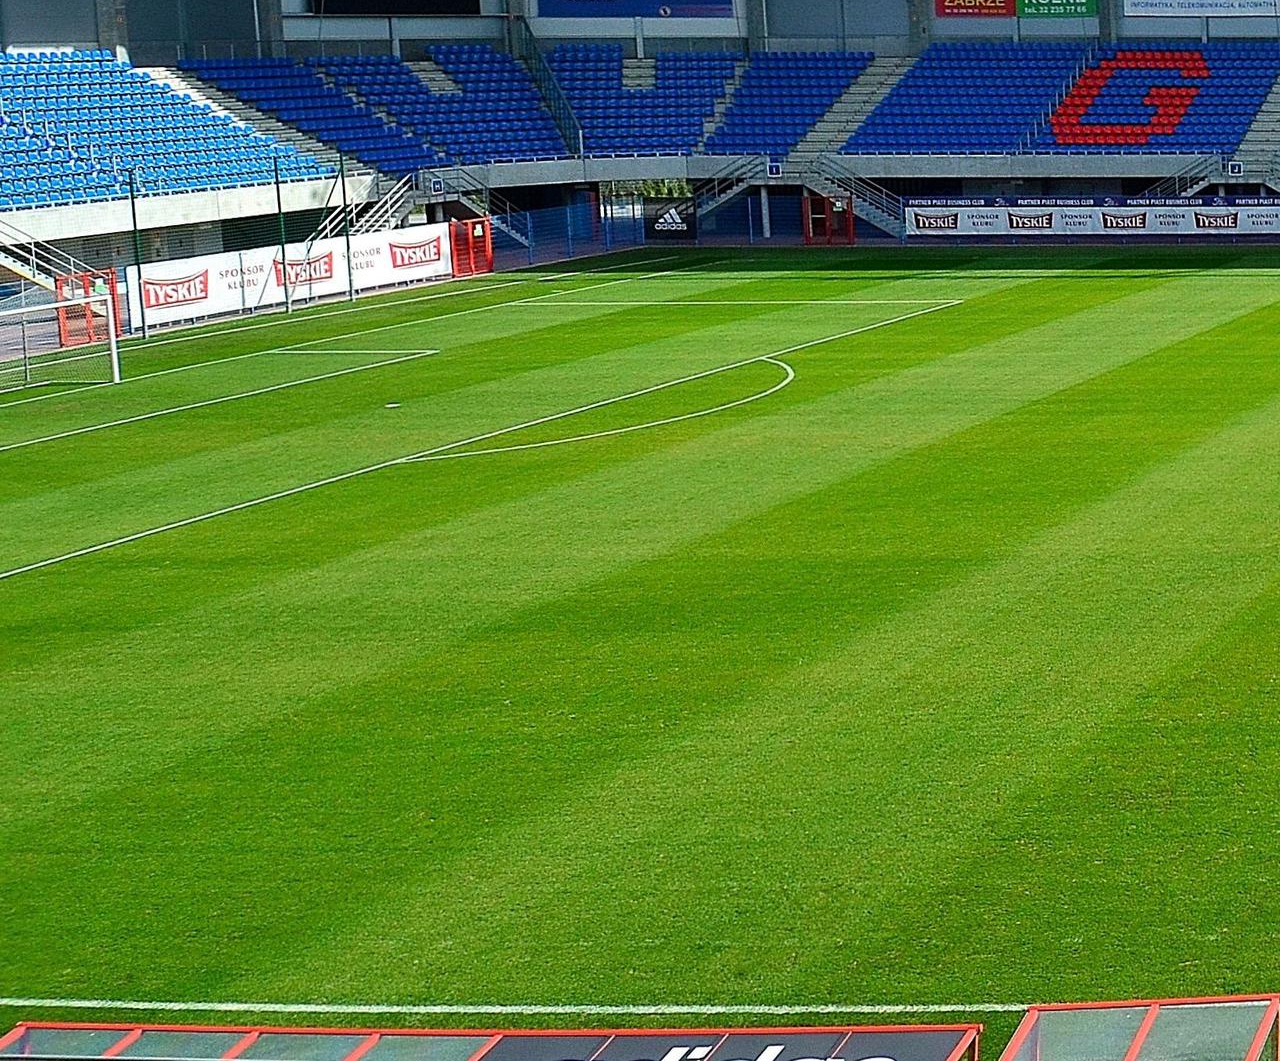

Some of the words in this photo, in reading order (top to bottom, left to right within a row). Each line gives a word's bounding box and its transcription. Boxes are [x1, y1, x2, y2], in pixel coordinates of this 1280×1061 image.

[654, 218, 687, 231] adidas
[918, 216, 956, 228] TYSKIE
[1012, 216, 1050, 228] TYSKIE
[1106, 215, 1144, 227] TYSKIE
[1198, 215, 1236, 227] TYSKIE
[341, 247, 381, 261] SONSOR
[392, 241, 441, 266] TYSKIE
[218, 264, 265, 280] SPONSOR
[277, 257, 330, 284] TYSKIE
[227, 277, 260, 290] KLUBU
[145, 276, 208, 306] TYSKIE
